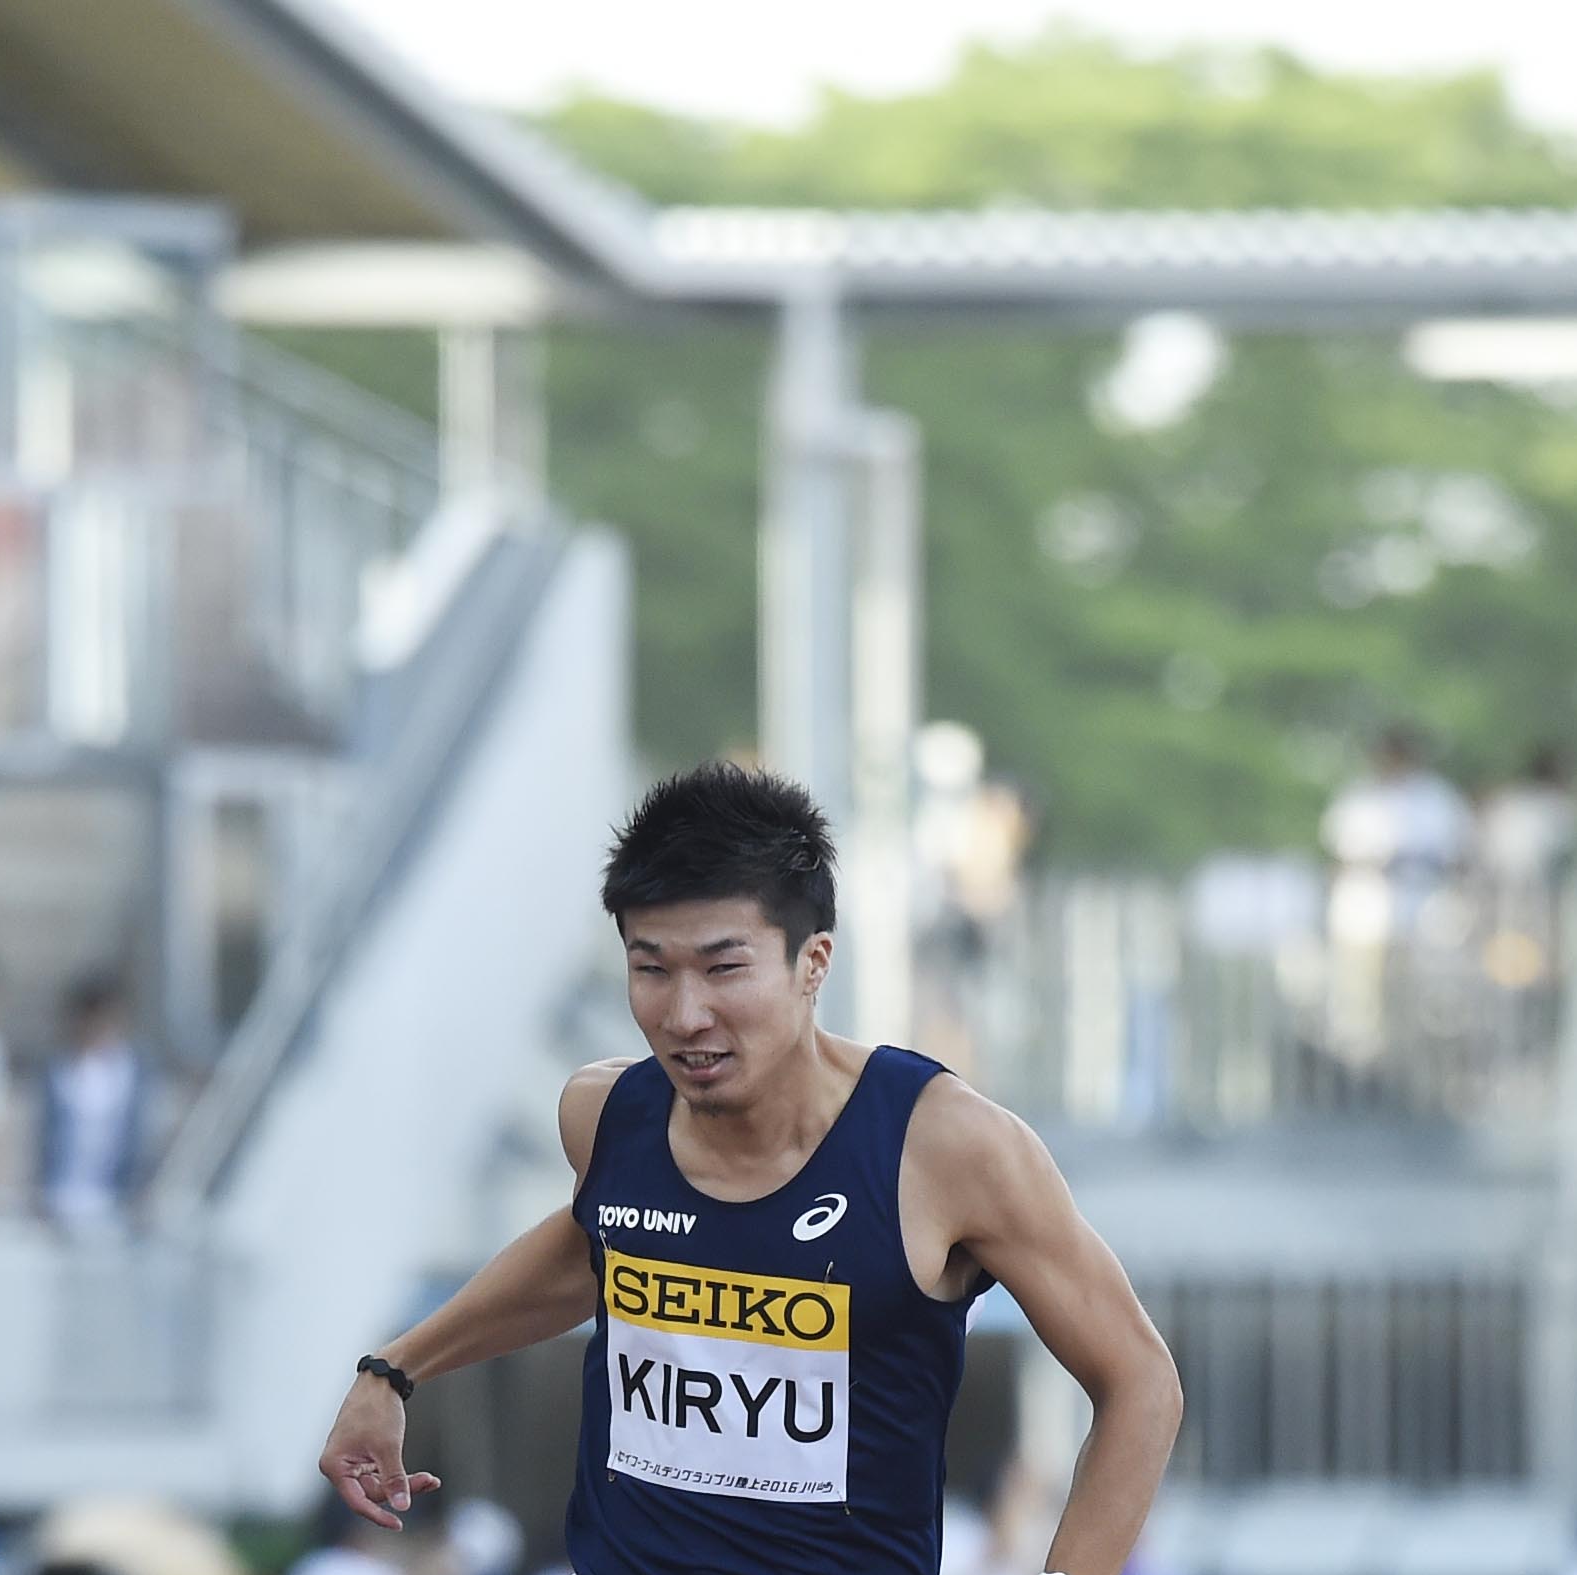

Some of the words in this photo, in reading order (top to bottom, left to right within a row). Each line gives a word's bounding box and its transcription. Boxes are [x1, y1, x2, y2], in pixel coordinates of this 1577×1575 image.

[598, 1204, 640, 1229] TOYO
[643, 1208, 697, 1235] UNIV
[612, 1265, 835, 1341] SEIKO
[618, 1352, 834, 1444] KIRYU
